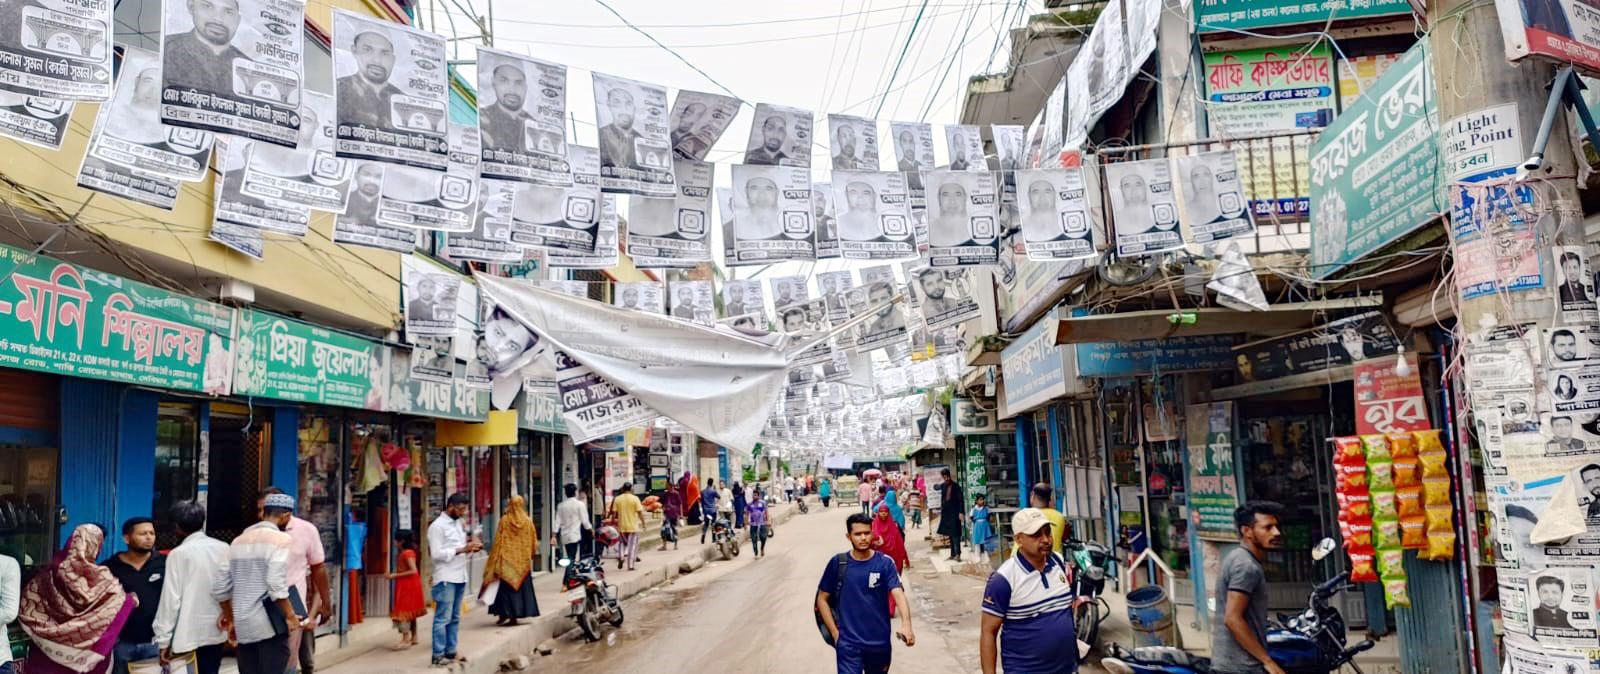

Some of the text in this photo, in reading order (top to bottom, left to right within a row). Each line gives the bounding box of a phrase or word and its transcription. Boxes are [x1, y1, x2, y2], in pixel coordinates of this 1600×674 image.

[1208, 51, 1331, 92] রাফি কম্পিউটার
[1458, 113, 1497, 134] Light
[1470, 127, 1513, 147] Point
[1310, 110, 1369, 187] ফয়েজ
[1460, 153, 1489, 169] ভবন
[102, 292, 206, 365] শিল্পালয়
[270, 319, 370, 383] প্রিয়া জুয়েলার্স
[563, 388, 588, 409] মোঃ
